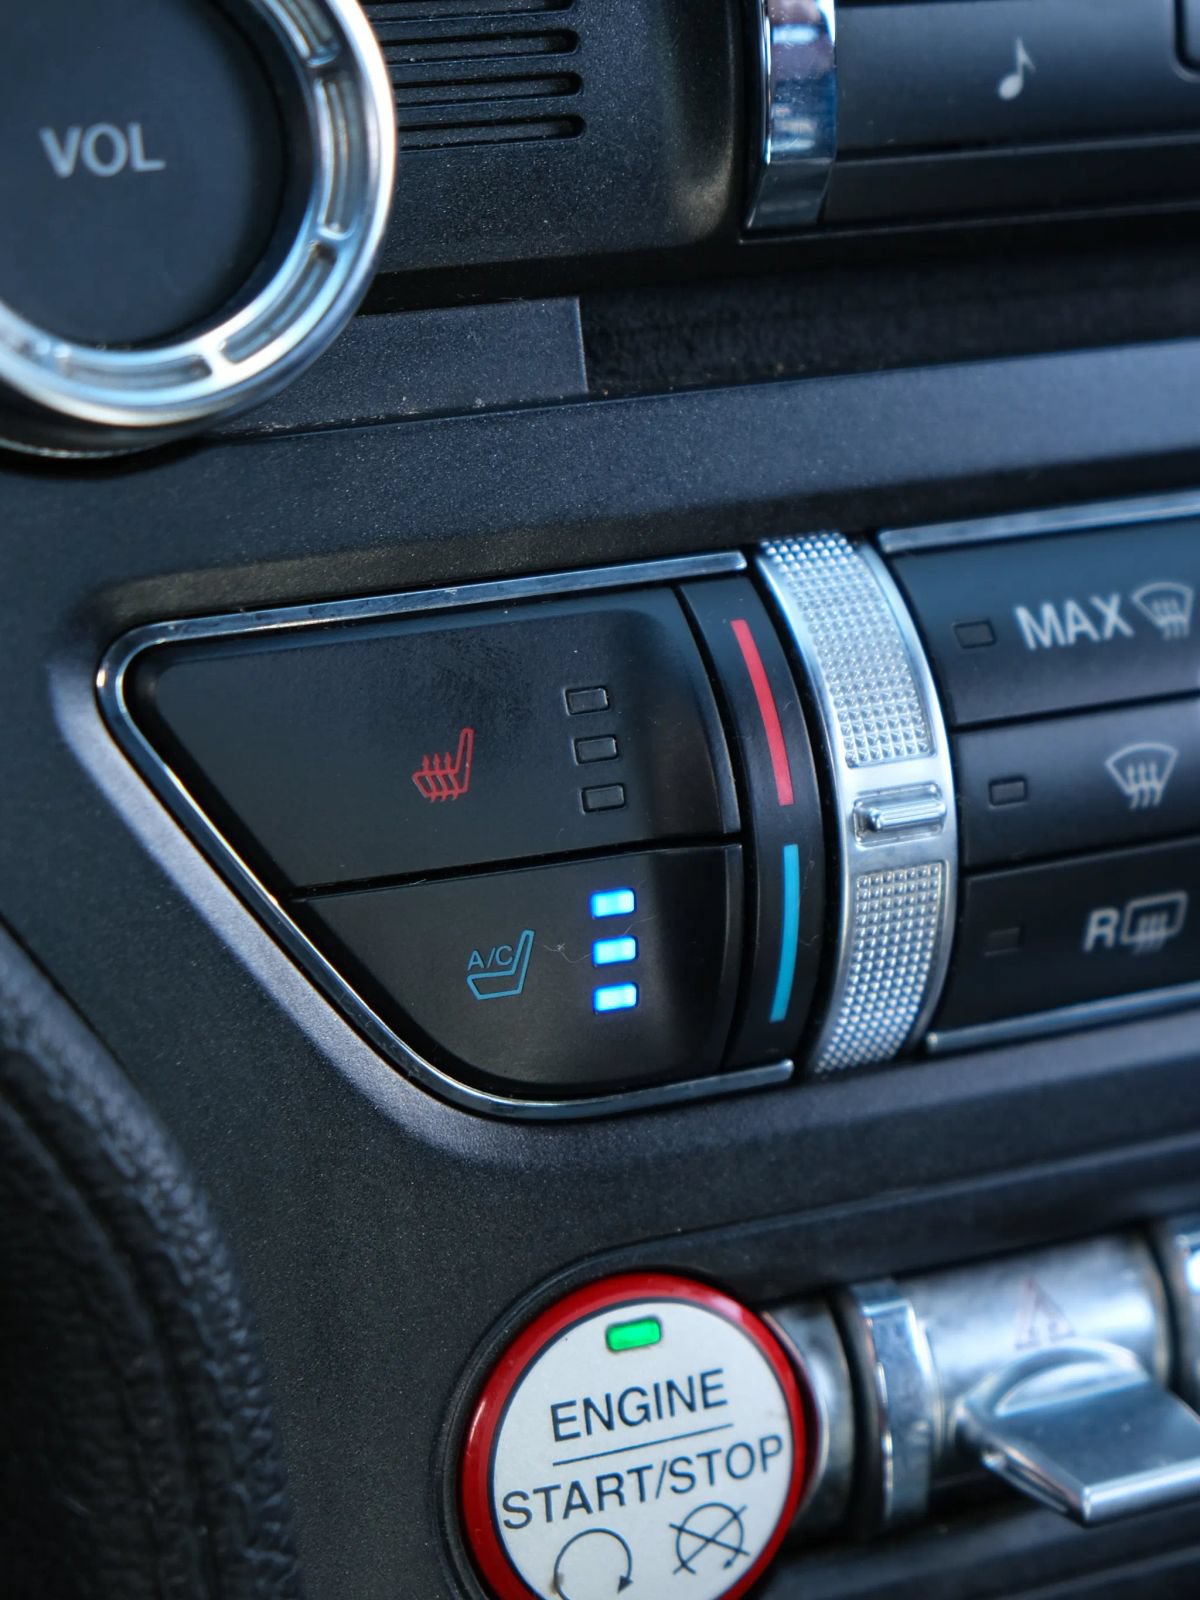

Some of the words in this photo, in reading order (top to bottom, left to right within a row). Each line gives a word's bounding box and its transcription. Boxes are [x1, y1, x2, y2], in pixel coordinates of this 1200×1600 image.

[40, 121, 165, 178] VOL
[1013, 593, 1135, 650] MAX
[467, 945, 514, 971] A/C
[1082, 906, 1117, 953] R
[550, 1368, 728, 1442] ENGINE
[502, 1434, 783, 1530] START/STOP
